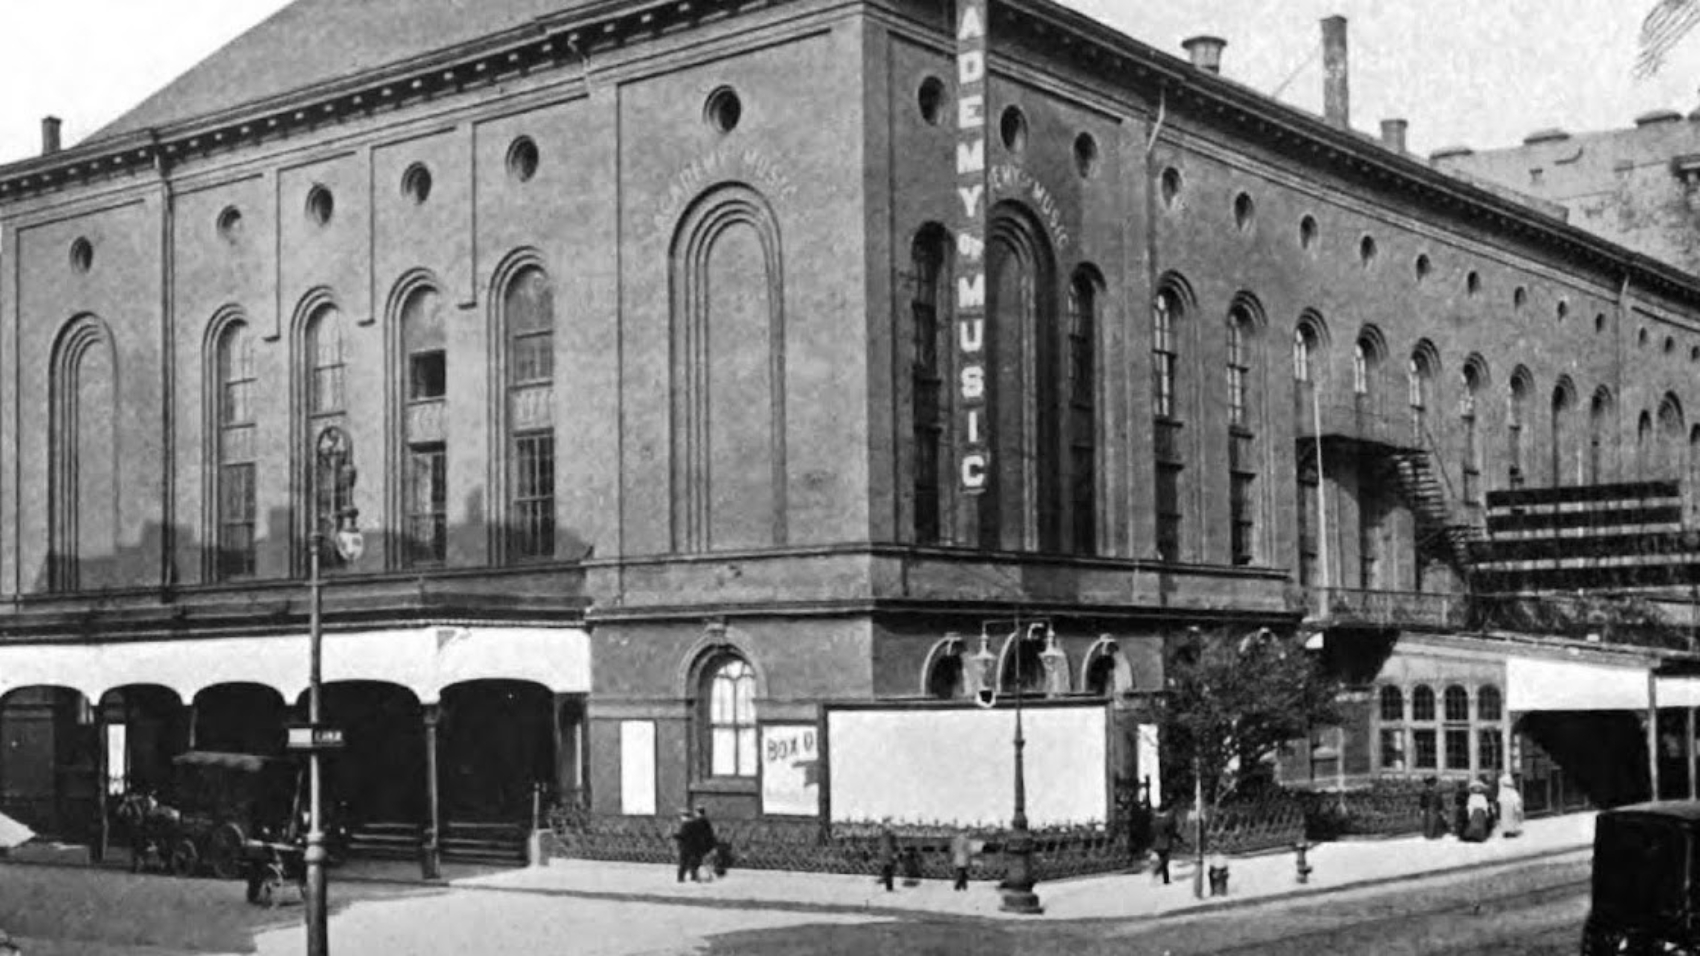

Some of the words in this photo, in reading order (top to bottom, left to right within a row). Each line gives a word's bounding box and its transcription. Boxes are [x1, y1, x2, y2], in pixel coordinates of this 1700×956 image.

[1033, 181, 1069, 248] MUSIC
[957, 273, 985, 488] MUSIC
[767, 737, 798, 762] BOX
